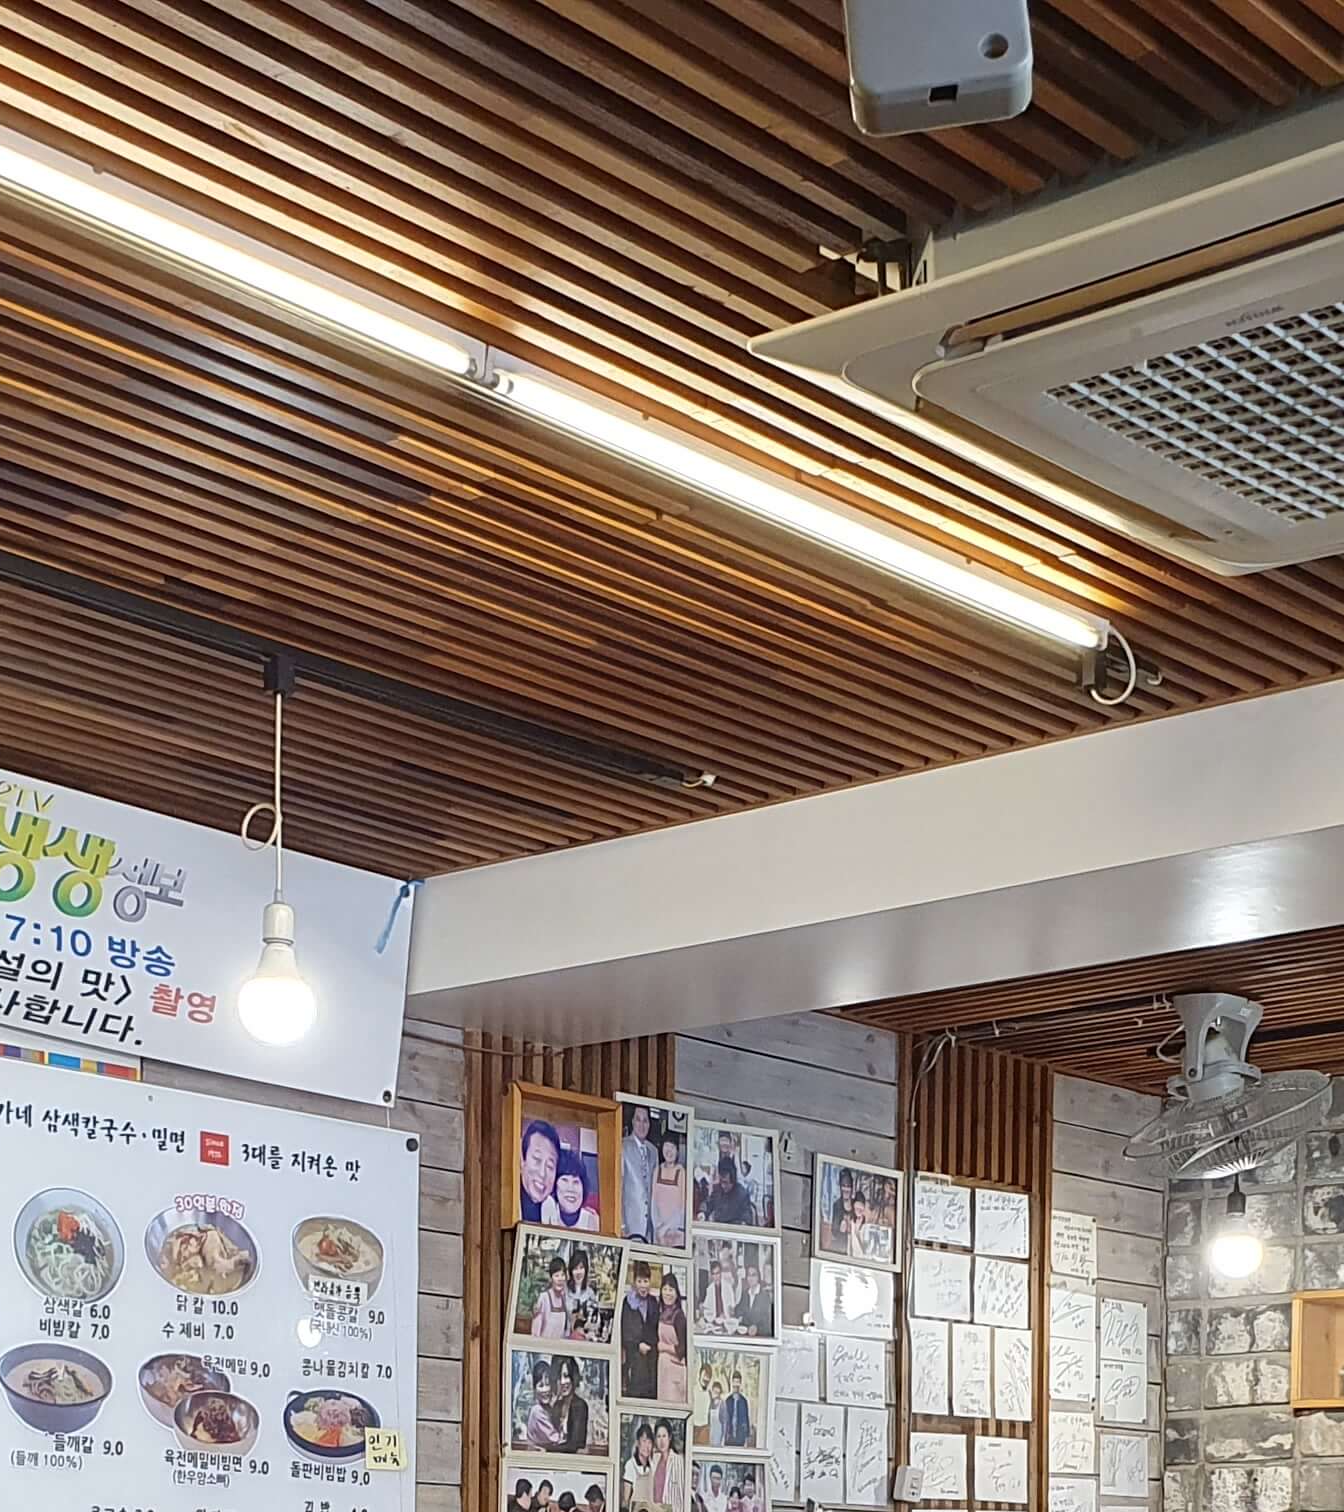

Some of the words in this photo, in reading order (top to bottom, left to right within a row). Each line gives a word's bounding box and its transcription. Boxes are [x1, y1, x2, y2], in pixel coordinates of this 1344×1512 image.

[107, 935, 176, 977] 방송
[149, 983, 216, 1025] 촬영
[241, 1143, 284, 1170] 3대를
[291, 1151, 338, 1178] 지켜온
[346, 1159, 362, 1182] 맛
[43, 1297, 84, 1318] 삼색칼
[89, 1303, 112, 1320] 6.0
[211, 1301, 239, 1316] 10.0
[369, 1310, 385, 1325] 9.0
[39, 1318, 81, 1339] 비빔칼
[90, 1323, 111, 1340] 7.0
[213, 1324, 235, 1340] 7.0
[203, 1355, 248, 1376] 육전메밀
[250, 1361, 271, 1379] 9.0
[376, 1363, 393, 1380] 7.0
[53, 1434, 94, 1455] 들깨칼
[102, 1441, 124, 1456] 9.0
[43, 1454, 84, 1471] 100%)
[164, 1449, 242, 1473] 육전메밀비빔면
[249, 1459, 269, 1475] 9.0
[290, 1461, 347, 1483] 돌판비빔밥
[351, 1471, 371, 1486] 9.0
